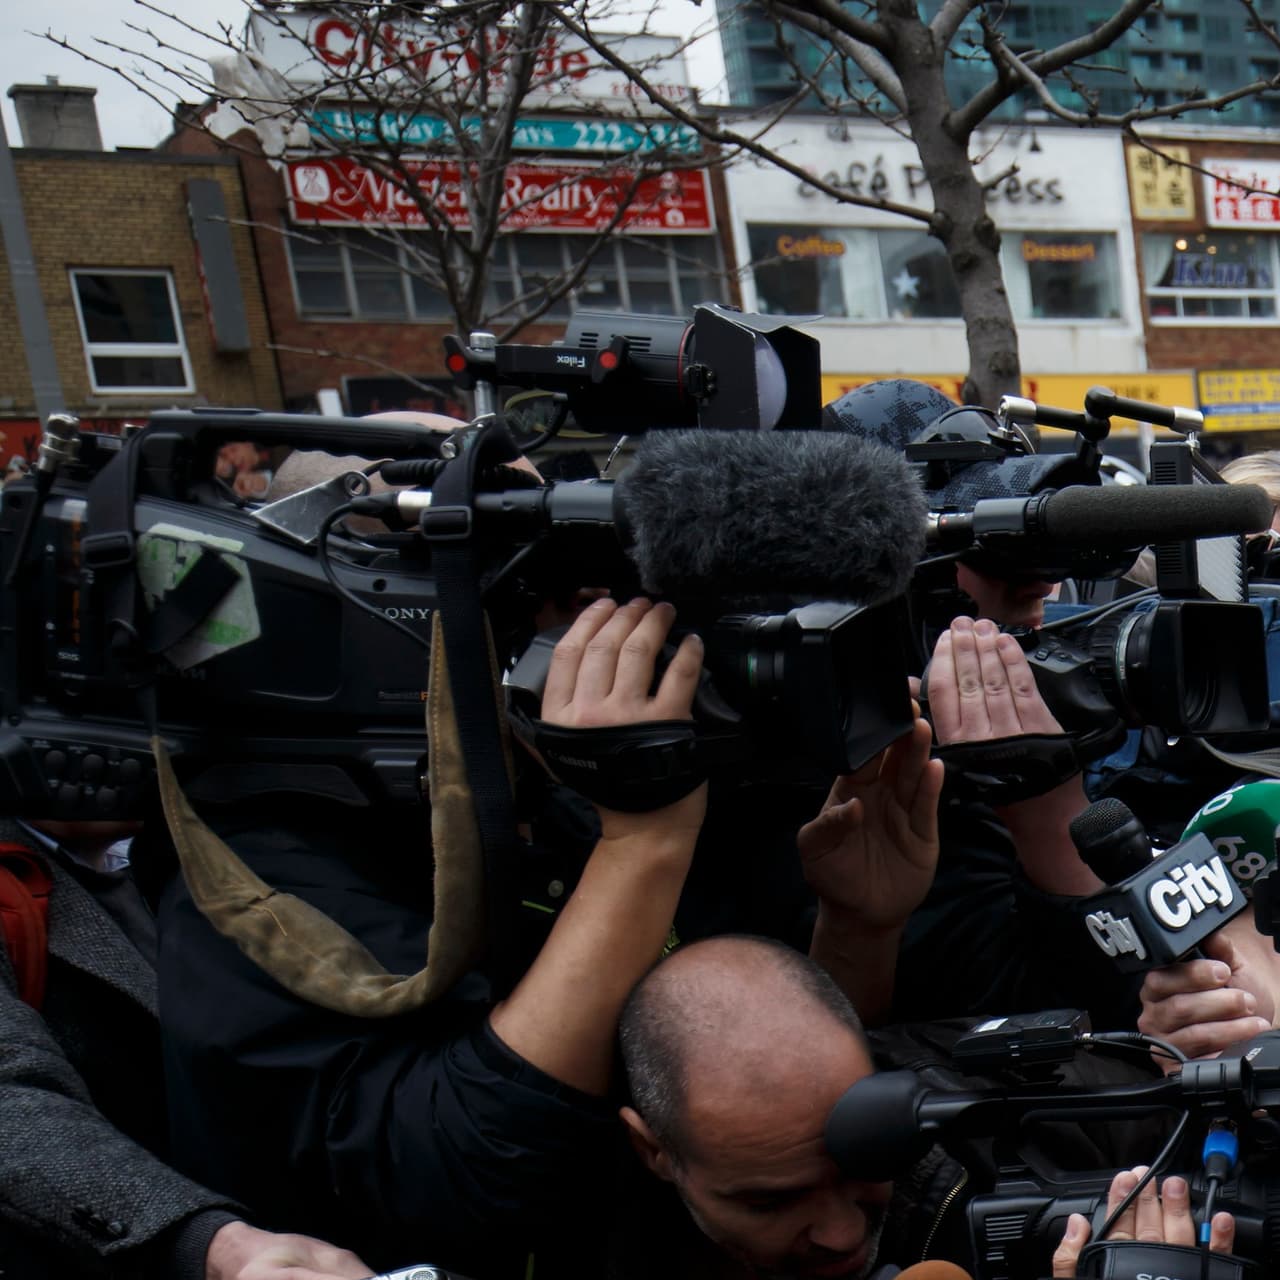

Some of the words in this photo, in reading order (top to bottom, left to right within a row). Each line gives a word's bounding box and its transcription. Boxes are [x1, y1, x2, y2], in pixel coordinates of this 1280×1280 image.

[315, 19, 589, 80] City-Wde
[1149, 856, 1234, 929] City
[1085, 909, 1147, 960] City
